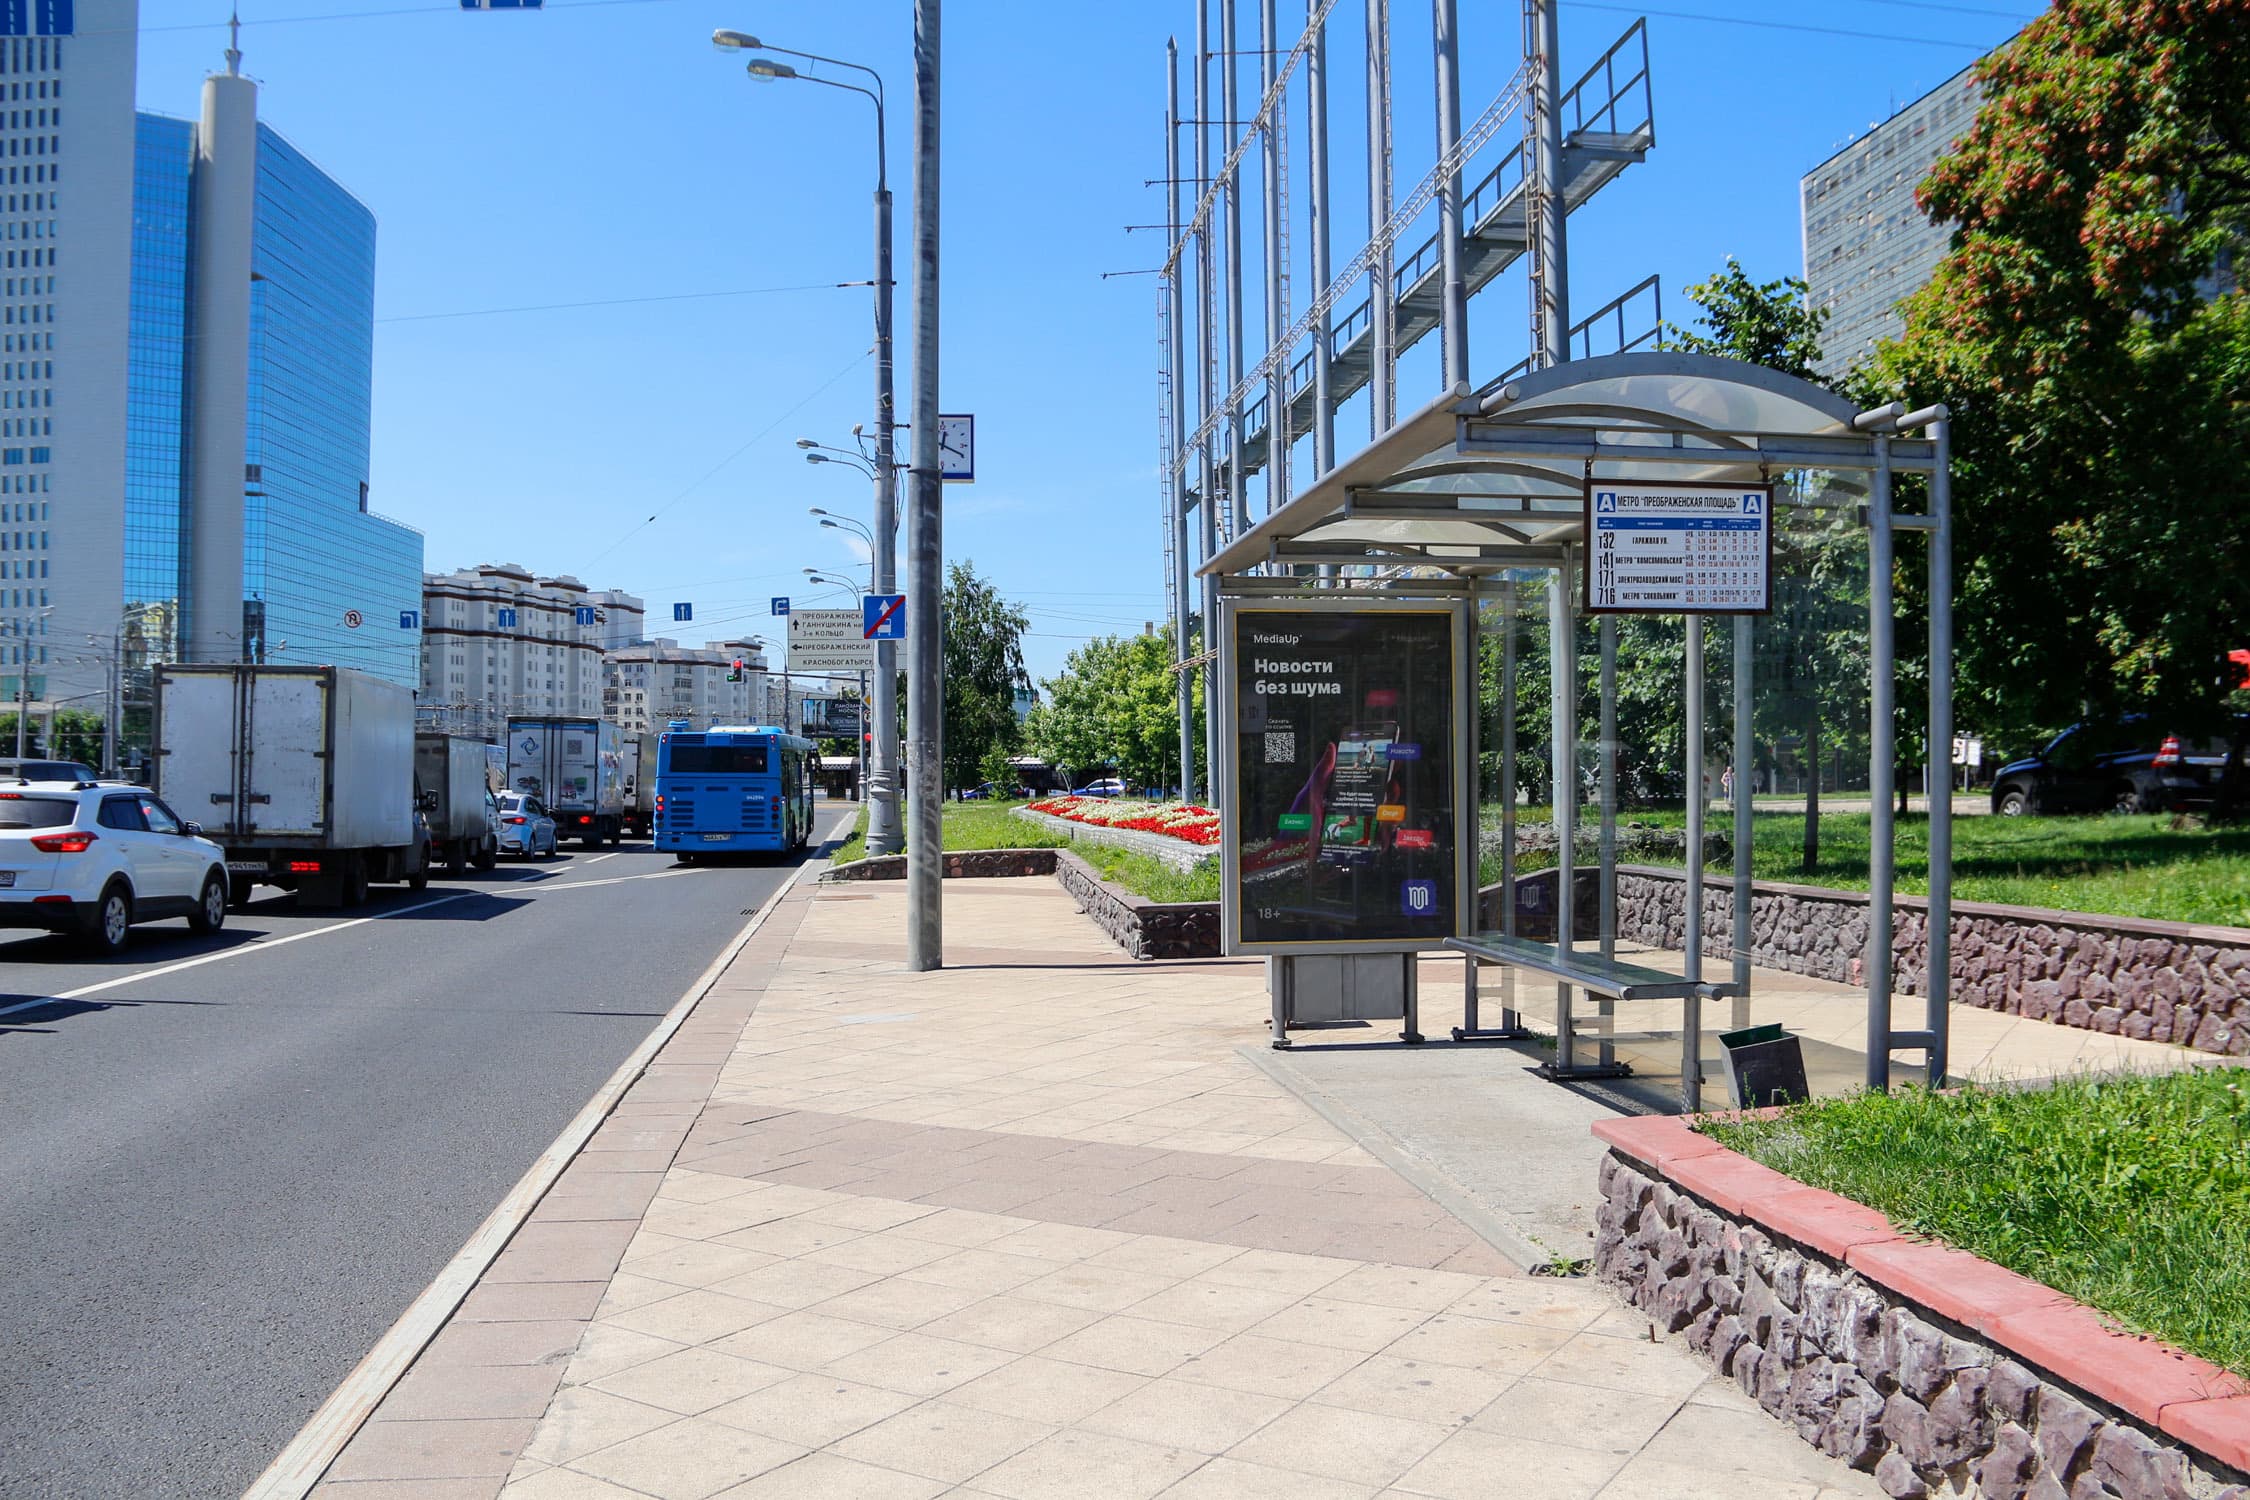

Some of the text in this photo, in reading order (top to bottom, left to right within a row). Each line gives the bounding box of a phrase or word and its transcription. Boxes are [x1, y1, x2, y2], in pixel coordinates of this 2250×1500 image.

[1617, 496, 1639, 507] МЕТРО
[1615, 556, 1633, 565] МЕТРО
[1598, 569, 1614, 587] 171
[1669, 575, 1684, 584] МОСТ
[1598, 587, 1616, 605] 716
[1622, 592, 1640, 600] МЕТРО
[815, 630, 844, 638] КОЛЬЦО
[802, 643, 871, 651] ПРЕОБРАЖЕНСКИЙ
[1254, 658, 1333, 673] Новости
[1255, 679, 1341, 698] без шума
[1258, 907, 1281, 919] 18+
